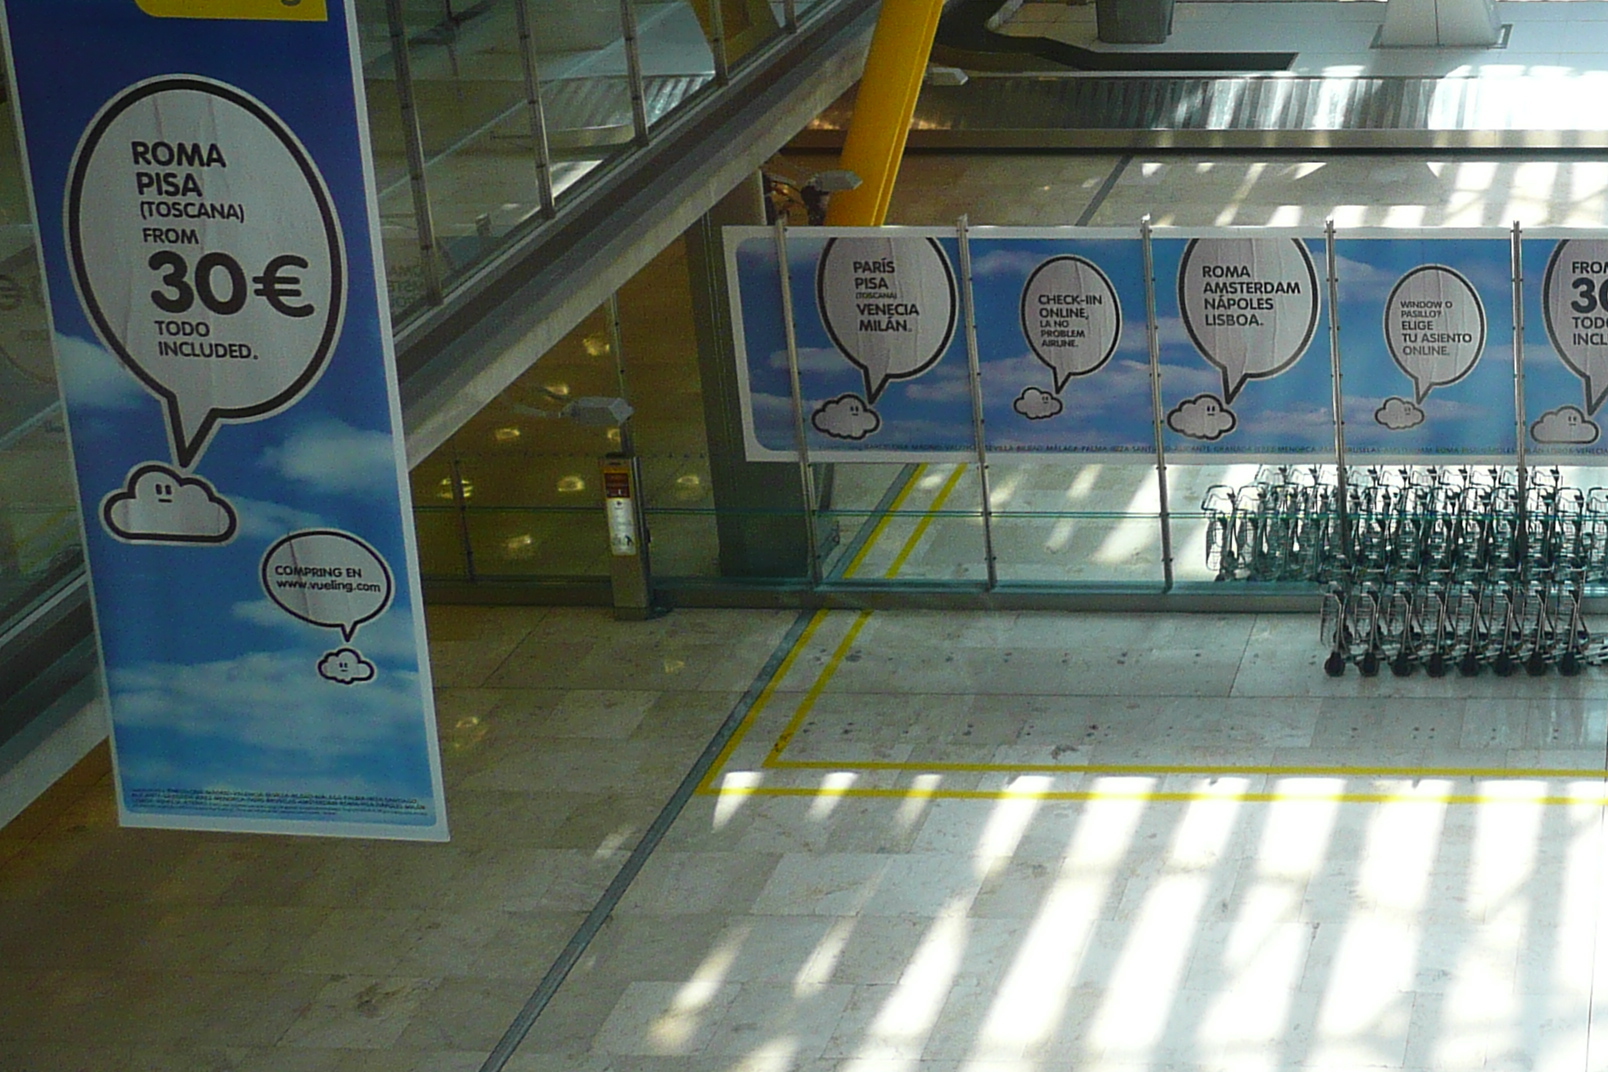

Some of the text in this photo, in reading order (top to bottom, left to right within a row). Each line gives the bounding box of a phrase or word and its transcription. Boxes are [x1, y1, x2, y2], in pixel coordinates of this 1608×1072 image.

[131, 141, 226, 168] ROMA
[135, 172, 203, 197] PISA
[140, 201, 244, 223] (TOSCANA)
[143, 228, 199, 245] FROM
[853, 257, 895, 273] PARÍS
[1202, 266, 1250, 278] ROMA
[855, 277, 888, 289] PISA
[1204, 282, 1300, 295] AMSTERDAM
[1039, 294, 1102, 305] CHECK-IIN
[1204, 294, 1273, 310] NÁPOLES
[1400, 301, 1453, 309] WINDOW O
[856, 303, 919, 316] VENECIA
[1039, 308, 1089, 319] ONLINE,
[1401, 310, 1441, 319] PASILLO?
[859, 316, 912, 332] MILÁN.
[1040, 320, 1069, 328] LA NO
[1205, 314, 1264, 326] LISBOA.
[1401, 320, 1433, 330] ELIGE
[155, 320, 210, 337] TODO
[1041, 330, 1085, 338] PROBLEM
[1402, 333, 1472, 343] TU ASIENTO
[158, 341, 259, 360] INCLUDED.
[1403, 345, 1450, 356] ONLINE.
[274, 565, 362, 579] COMPRING EN
[276, 579, 382, 594] www.vueling.com
